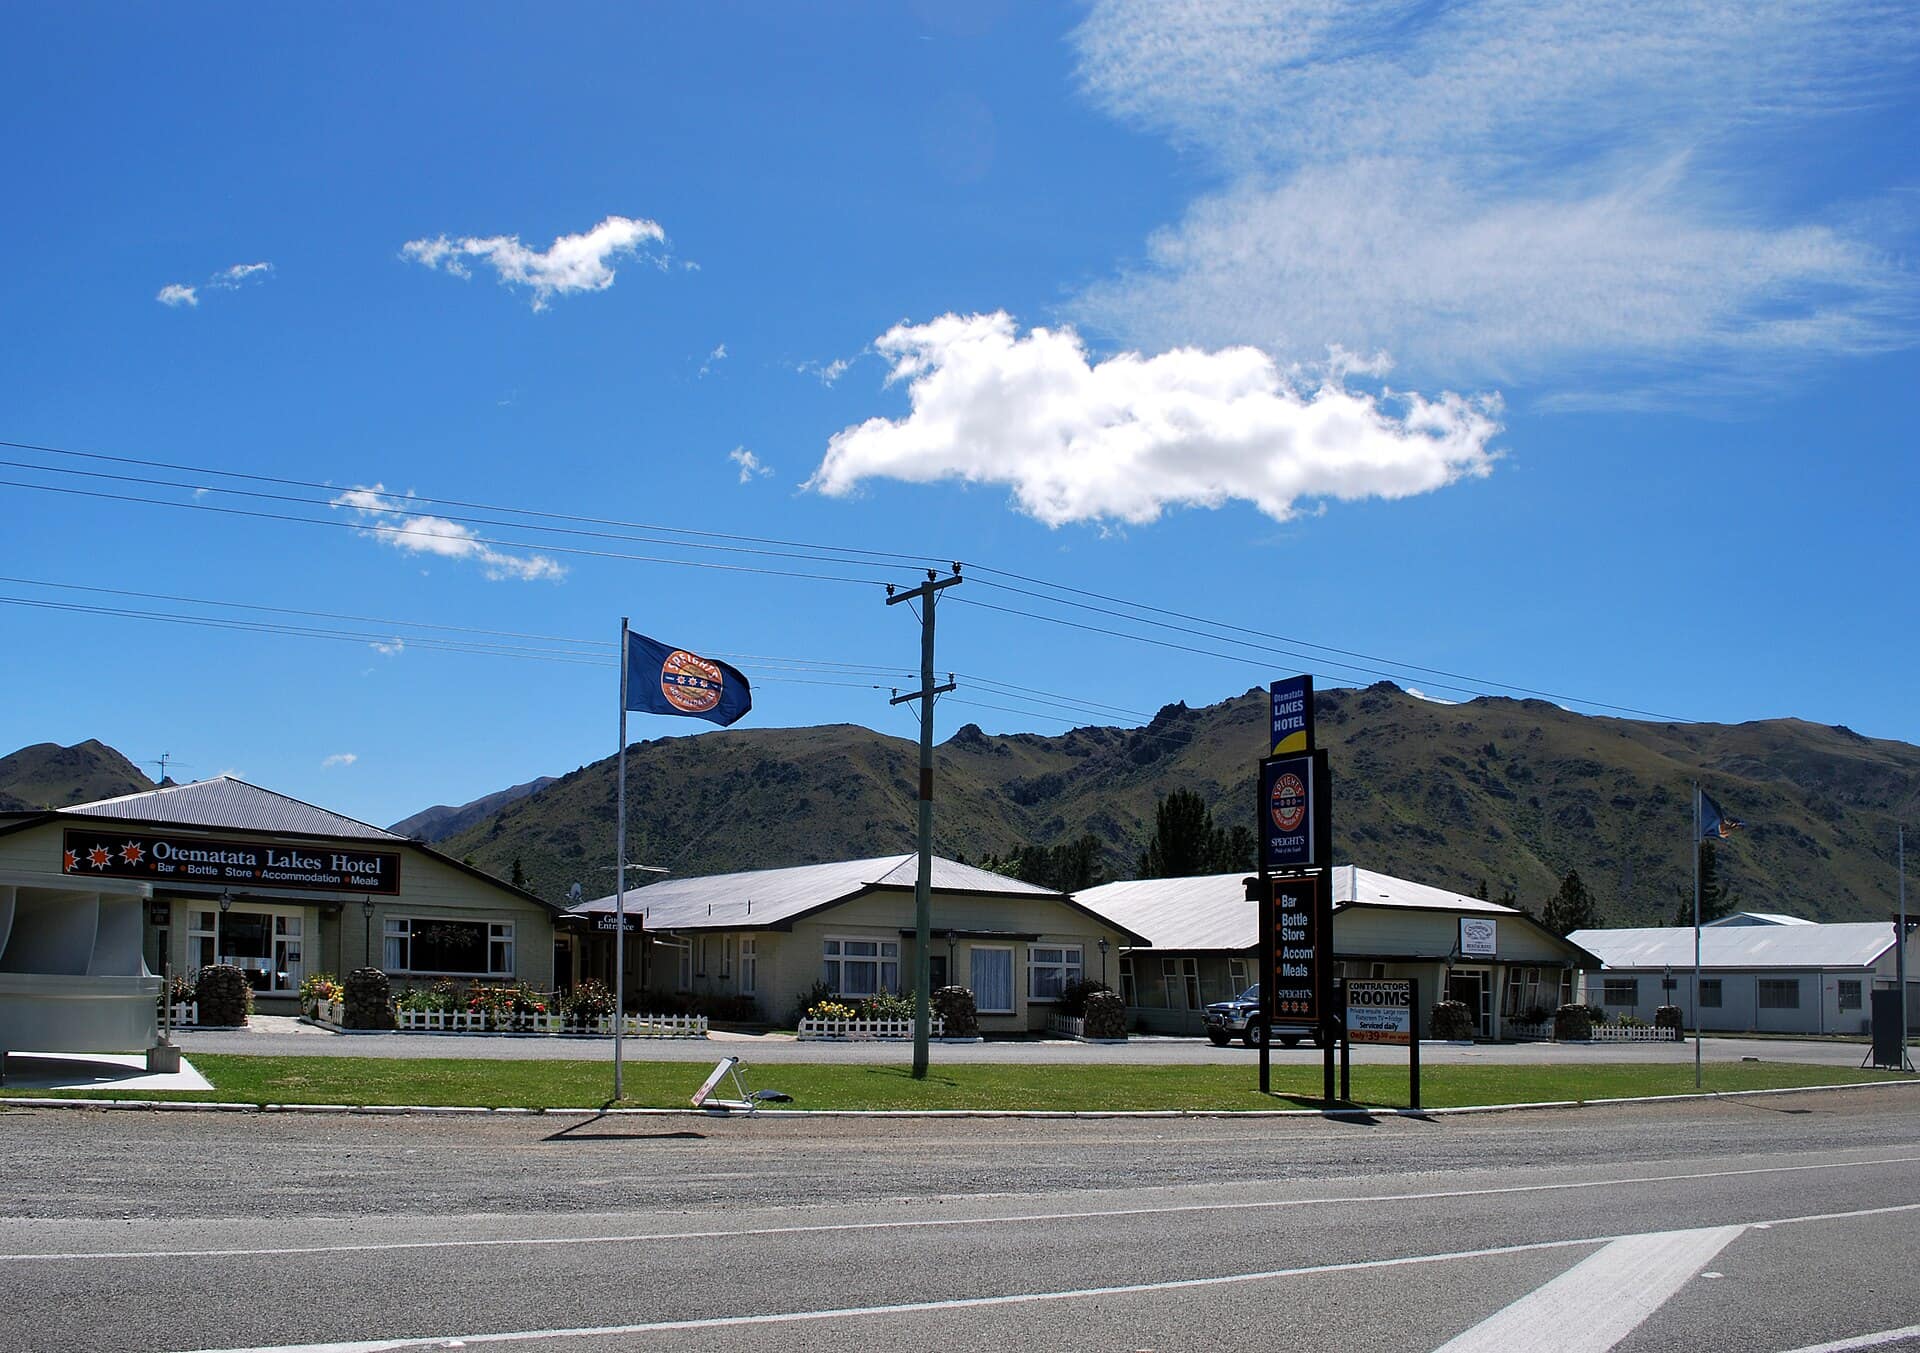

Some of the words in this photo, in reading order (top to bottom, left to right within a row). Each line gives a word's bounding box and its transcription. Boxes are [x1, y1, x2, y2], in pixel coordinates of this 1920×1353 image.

[1275, 700, 1304, 716] LAKES
[1274, 716, 1305, 732] HOTEL
[1271, 836, 1305, 847] SPEIGHT'S
[152, 841, 257, 866] Otematata
[266, 849, 322, 870] Lakes
[330, 854, 381, 874] Hotel
[157, 862, 176, 873] Bar
[187, 864, 218, 875] Bottle
[225, 866, 253, 878] Store
[261, 869, 341, 883] Accommodation
[351, 875, 379, 886] Meals
[1281, 894, 1297, 908] Bar
[1281, 912, 1308, 927] Bottle
[1281, 927, 1305, 941] Store
[1282, 945, 1316, 959] Accom'
[1282, 963, 1308, 977] Meals
[1349, 982, 1409, 991] CONTRACTORS
[1278, 989, 1312, 999] SPEIGHT'S
[1350, 991, 1409, 1006] ROOMS
[1360, 1021, 1383, 1030] Serviced
[1384, 1022, 1399, 1032] daily
[1350, 1031, 1365, 1040] Only
